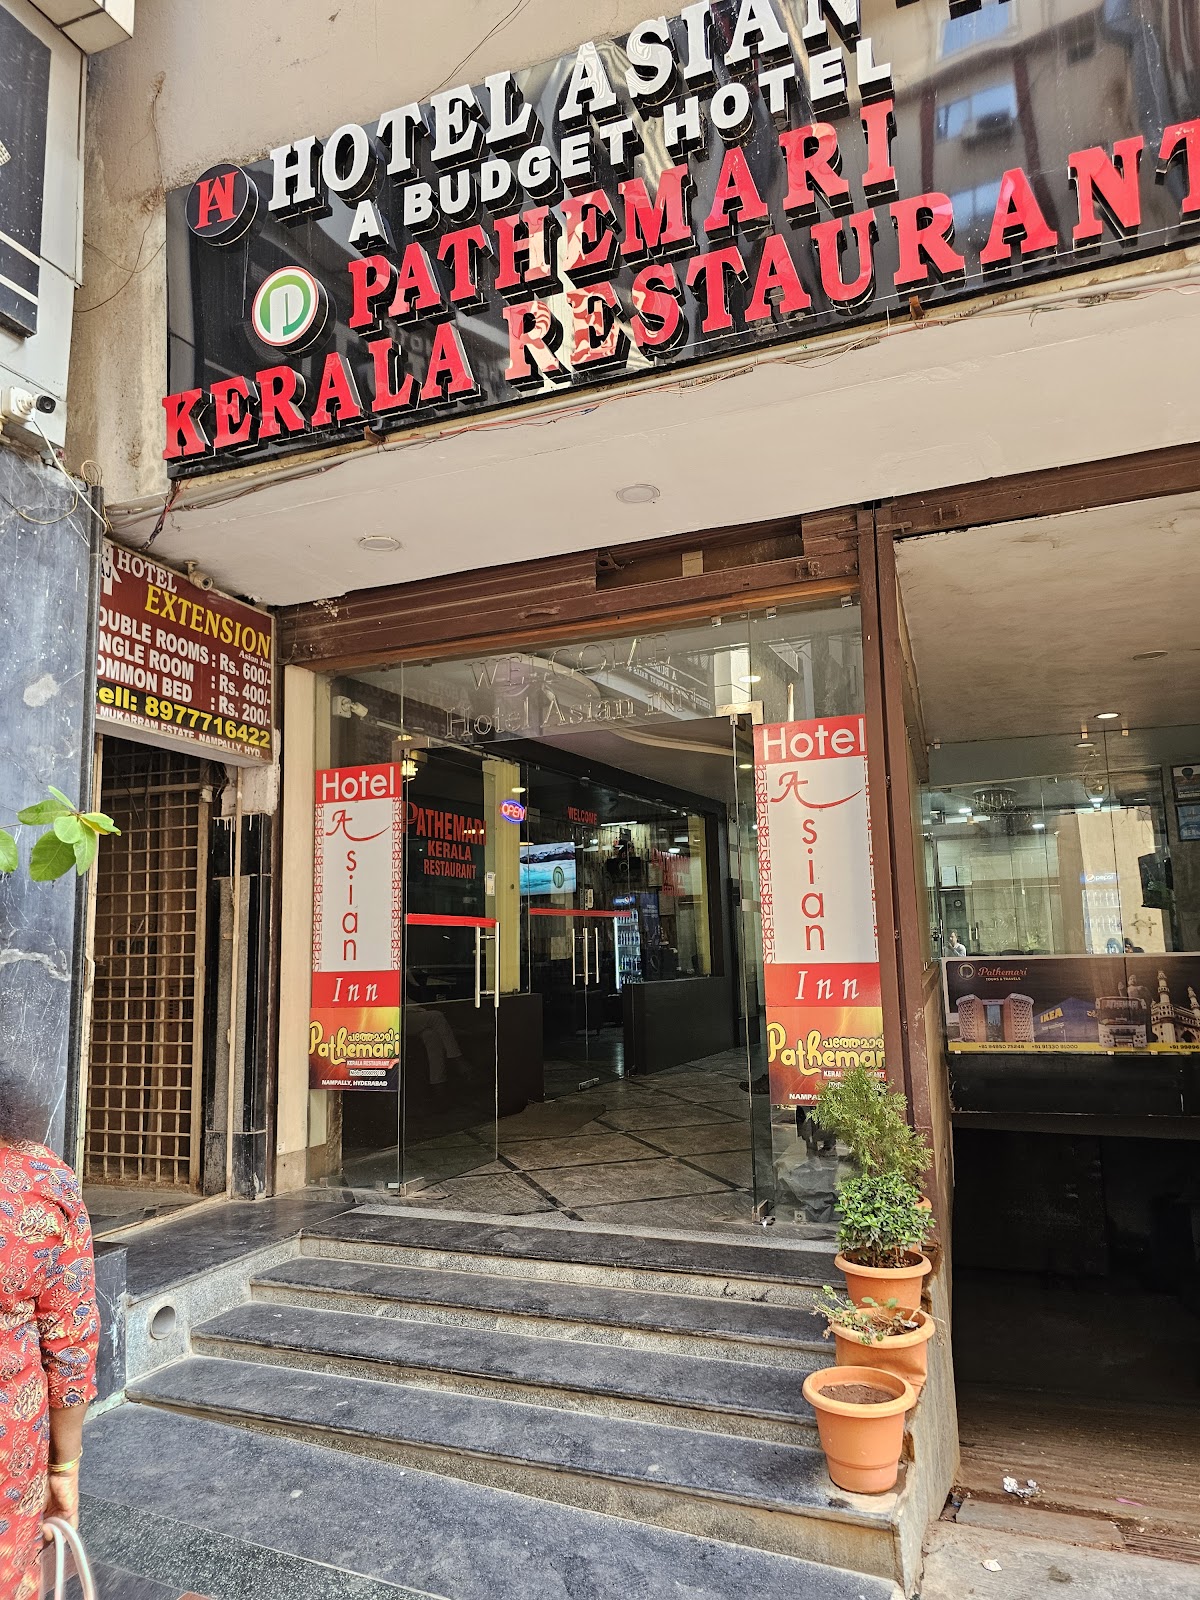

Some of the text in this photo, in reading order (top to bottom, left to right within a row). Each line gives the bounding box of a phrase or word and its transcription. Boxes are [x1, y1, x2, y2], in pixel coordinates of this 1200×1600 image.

[268, 71, 532, 211] HOTEL
[348, 38, 892, 245] A BUDGET HOTEL
[348, 98, 897, 330] PATHEMARI
[162, 118, 1200, 460] KERALA RESTAURANT
[117, 548, 178, 593] HOTEL
[145, 584, 271, 659] EXTENSION
[99, 605, 152, 644] OUBLE
[156, 628, 209, 665] ROOMS
[220, 652, 240, 677] Rs.
[242, 662, 271, 686] 600/-
[99, 630, 145, 665] NGLE
[149, 649, 194, 682] ROOM
[220, 673, 240, 697] Rs.
[242, 683, 271, 706] 400/-
[239, 649, 271, 669] Asian Inn
[465, 634, 671, 691] WELCOME
[97, 653, 157, 693] OMMON
[162, 676, 192, 703] BED
[219, 694, 239, 718] Rs.
[242, 703, 271, 726] 200/-
[444, 697, 531, 739] Hotel
[541, 682, 636, 728] Asian
[100, 706, 159, 730] MUKARRAM
[145, 696, 271, 749] 8977716422
[763, 718, 866, 761] Hotel
[322, 766, 395, 801] Hotel
[402, 801, 487, 847] PATHEMARI
[501, 803, 526, 820] OPEN
[567, 806, 598, 824] WELCOME
[423, 858, 476, 879] RESTAURANT
[428, 839, 472, 861] KERALA
[770, 770, 863, 950] Asian
[325, 809, 391, 961] Asian
[1095, 873, 1114, 881] pepsi
[332, 977, 379, 1002] Inn
[795, 970, 860, 1000] Inn
[978, 967, 1028, 976] Pathemari
[1040, 1008, 1063, 1023] IKEA
[309, 1020, 400, 1065] Pathemari
[766, 1022, 886, 1076] Pathemar
